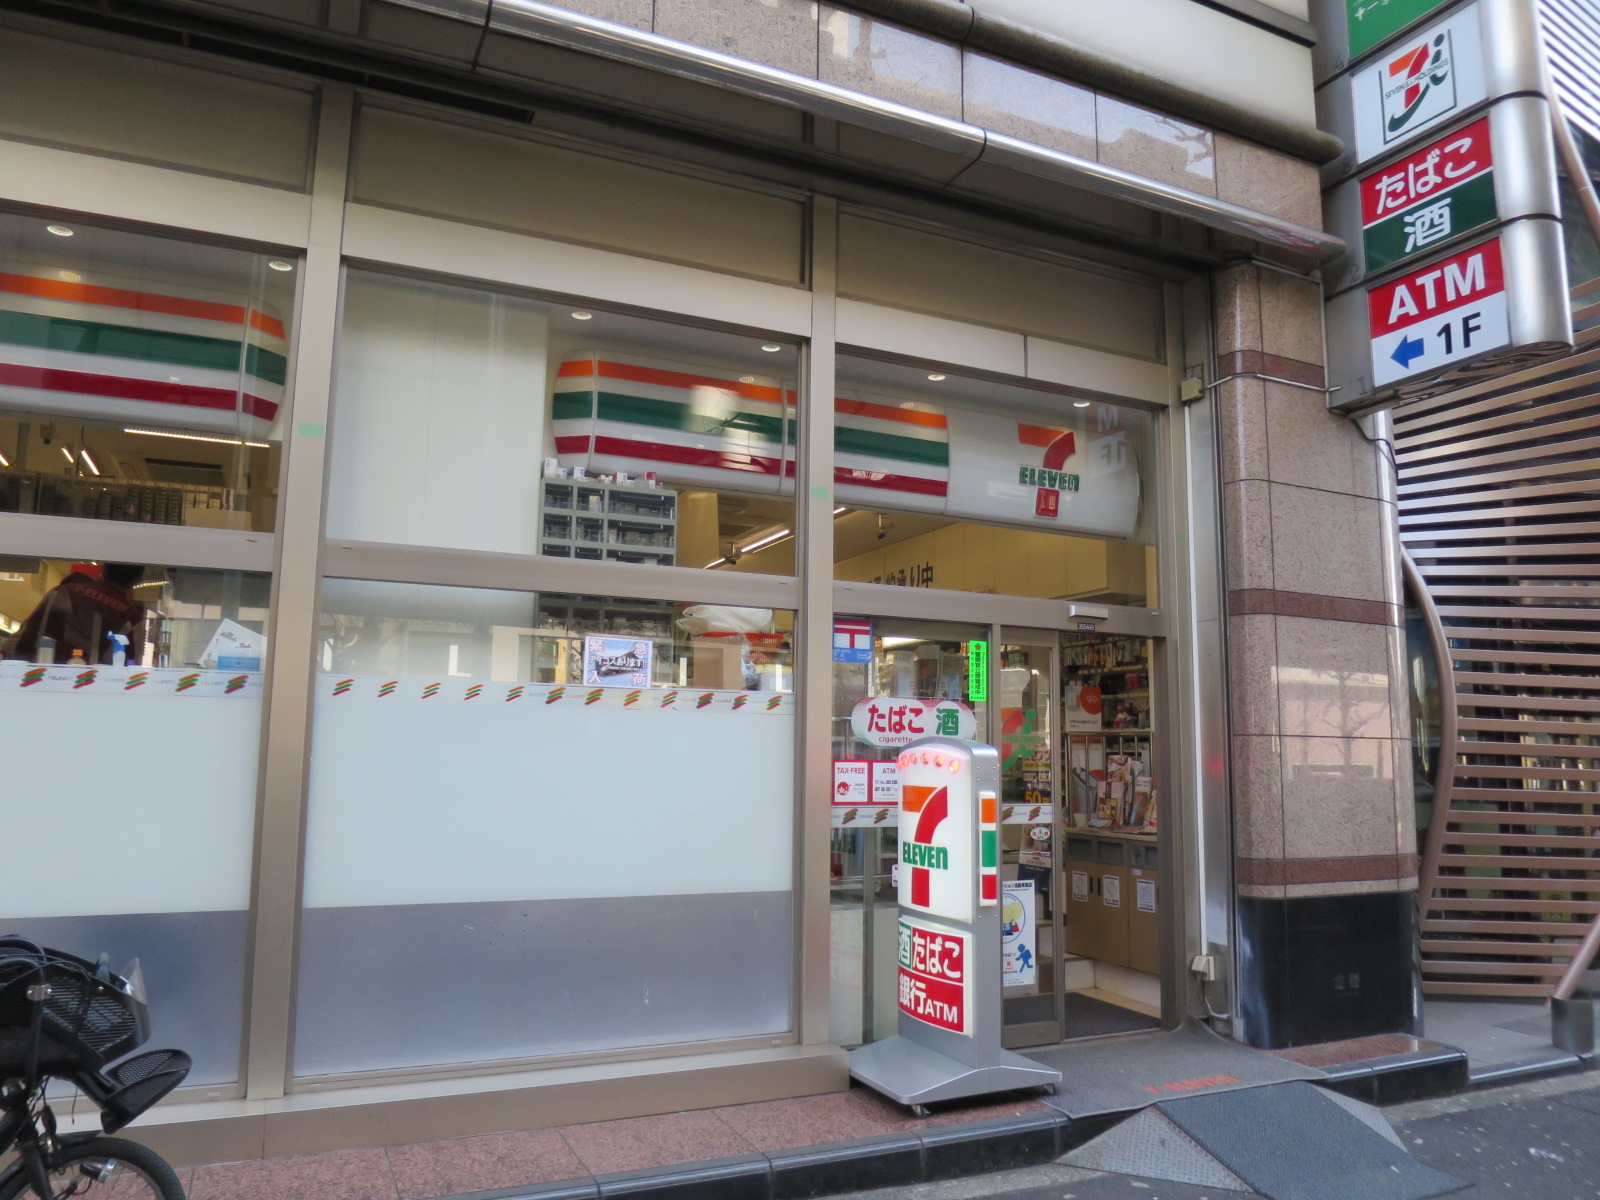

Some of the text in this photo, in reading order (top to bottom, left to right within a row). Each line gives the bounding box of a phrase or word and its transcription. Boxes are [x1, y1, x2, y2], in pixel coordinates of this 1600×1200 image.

[1375, 137, 1477, 214] たばこ
[1403, 198, 1452, 253] 酒
[1387, 253, 1486, 325] ATM
[1436, 311, 1482, 355] 1F
[632, 672, 648, 686] 荷
[867, 704, 960, 736] たばこ 酒
[878, 735, 913, 744] cigarette
[882, 767, 896, 775] ATM
[912, 931, 961, 979] たばこ
